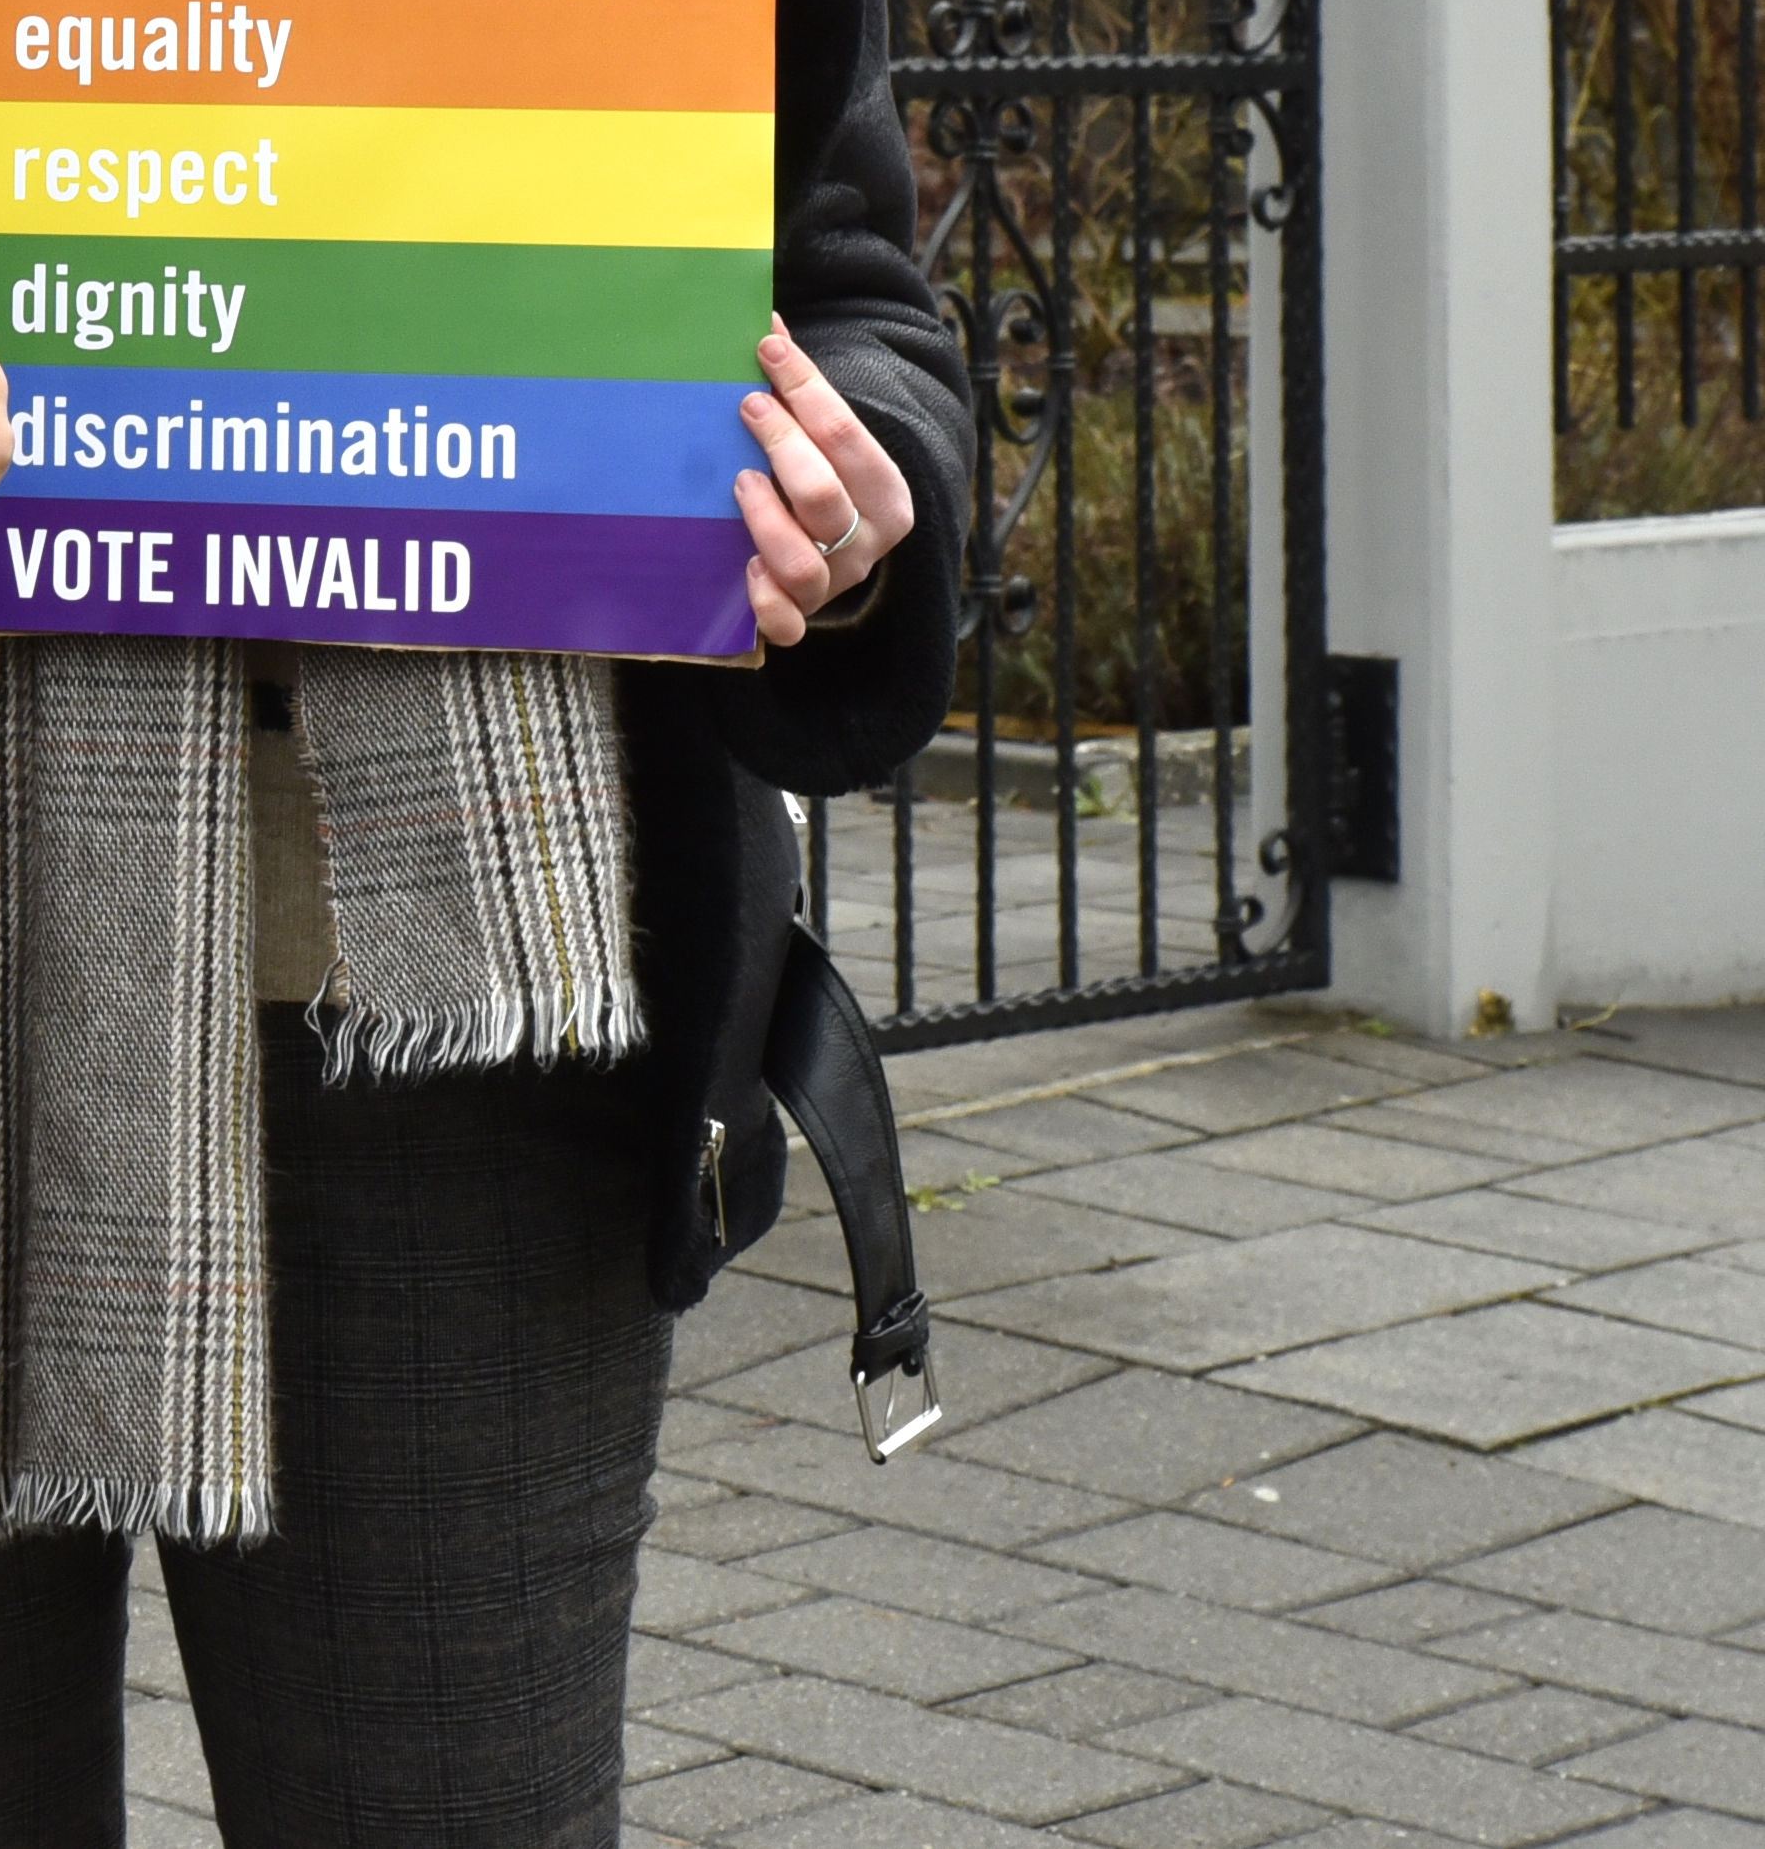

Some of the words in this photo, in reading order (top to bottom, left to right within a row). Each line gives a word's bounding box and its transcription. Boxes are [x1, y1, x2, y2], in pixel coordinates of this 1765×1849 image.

[16, 1, 291, 88] equality
[15, 139, 278, 218] respect
[12, 264, 245, 352] dignity
[11, 395, 516, 480] discrimination
[7, 528, 173, 603] VOTE
[206, 534, 470, 612] INVALID
